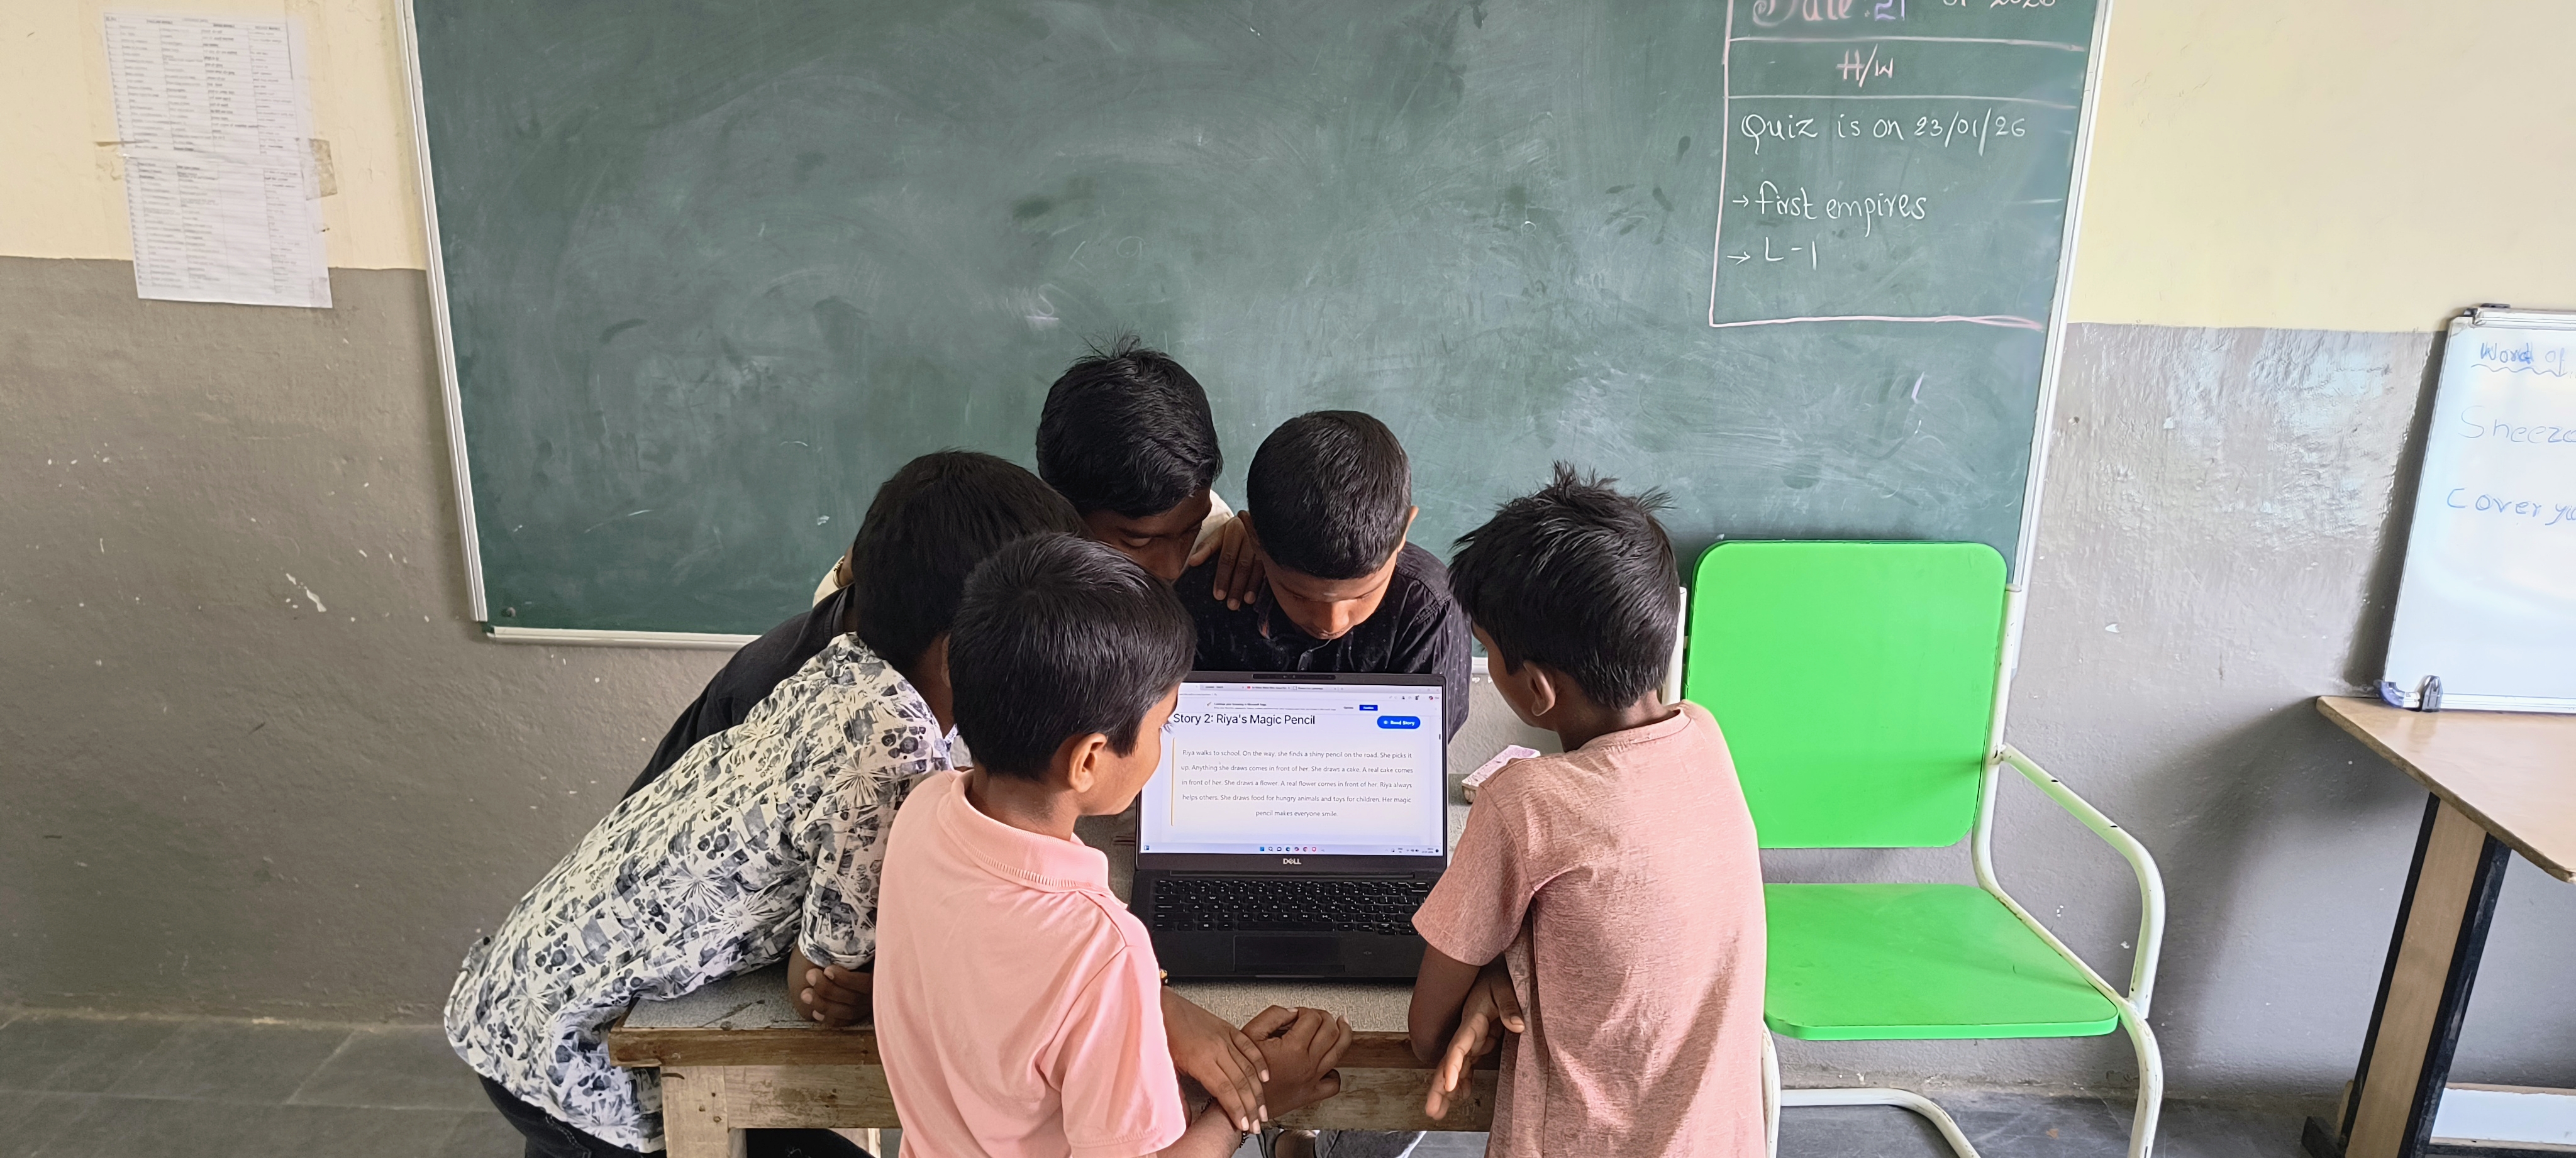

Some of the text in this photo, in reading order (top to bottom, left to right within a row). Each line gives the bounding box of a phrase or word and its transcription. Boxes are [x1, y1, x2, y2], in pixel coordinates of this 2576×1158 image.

[1740, 108, 2026, 157] Quiz is on 23/01/26
[1826, 193, 1927, 238] empires
[2480, 343, 2534, 364] Word
[1174, 713, 1315, 726] Story 2: Riya's Magic Pencil
